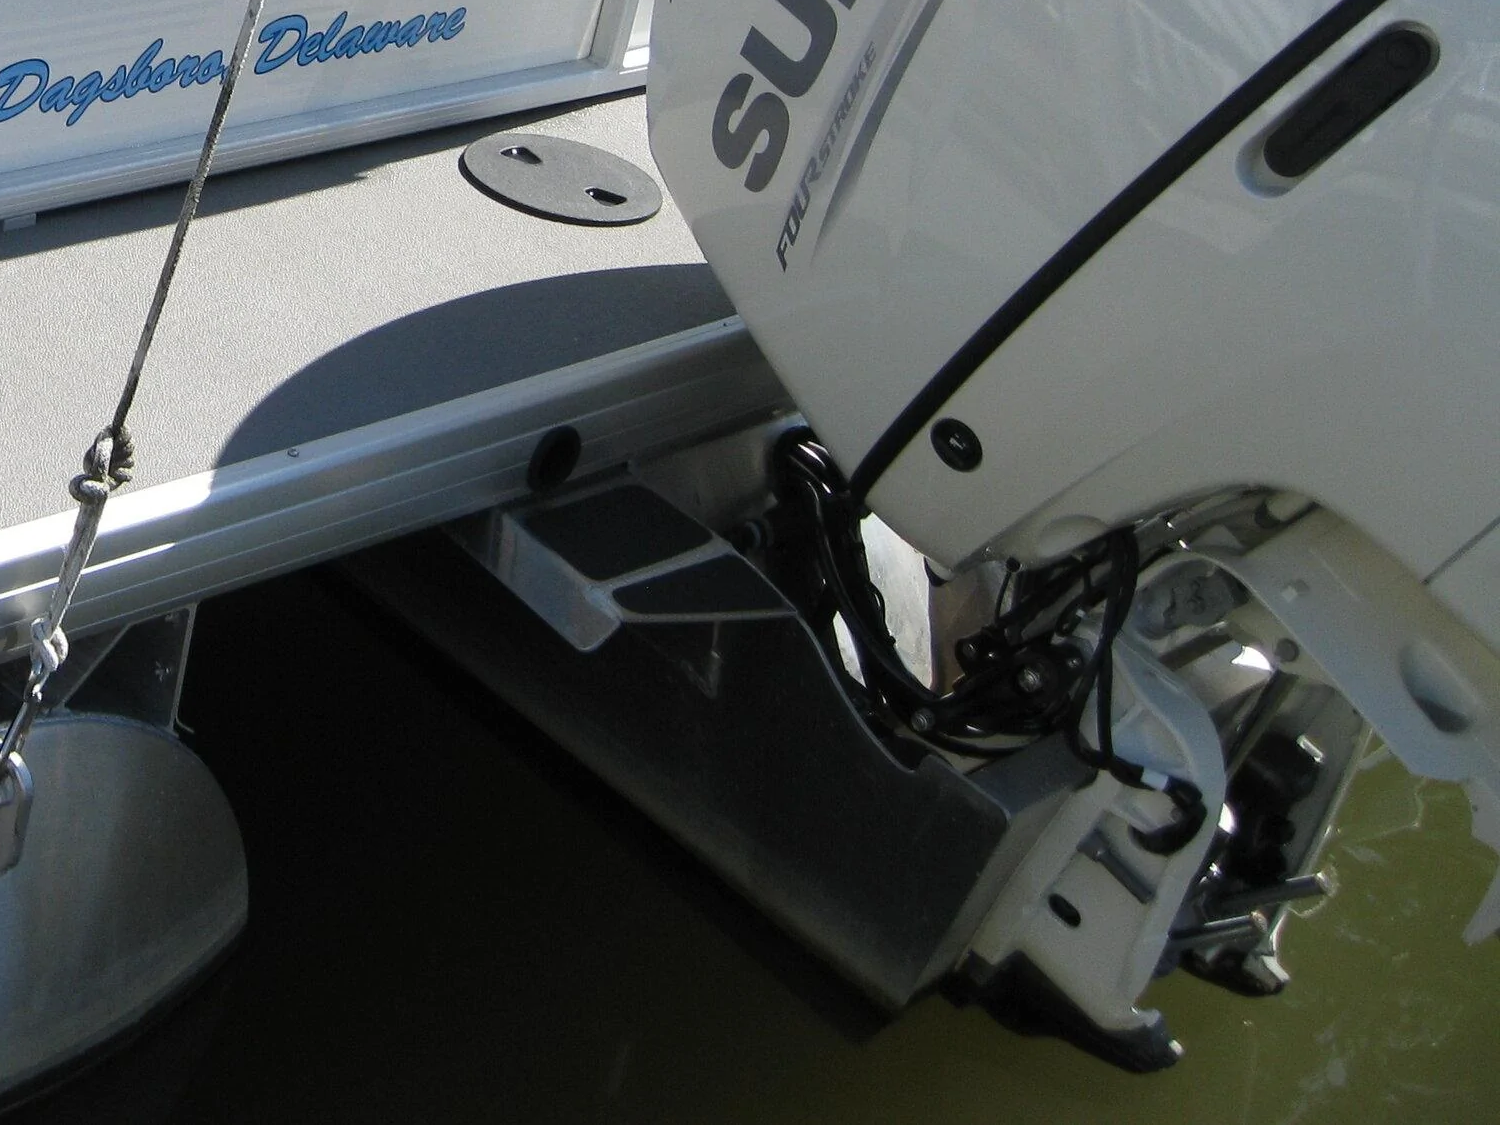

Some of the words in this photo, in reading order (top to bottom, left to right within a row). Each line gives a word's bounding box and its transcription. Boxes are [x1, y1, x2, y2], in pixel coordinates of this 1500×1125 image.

[254, 6, 468, 75] Delaware
[776, 156, 822, 273] FOUR
[818, 40, 877, 169] STROKE
